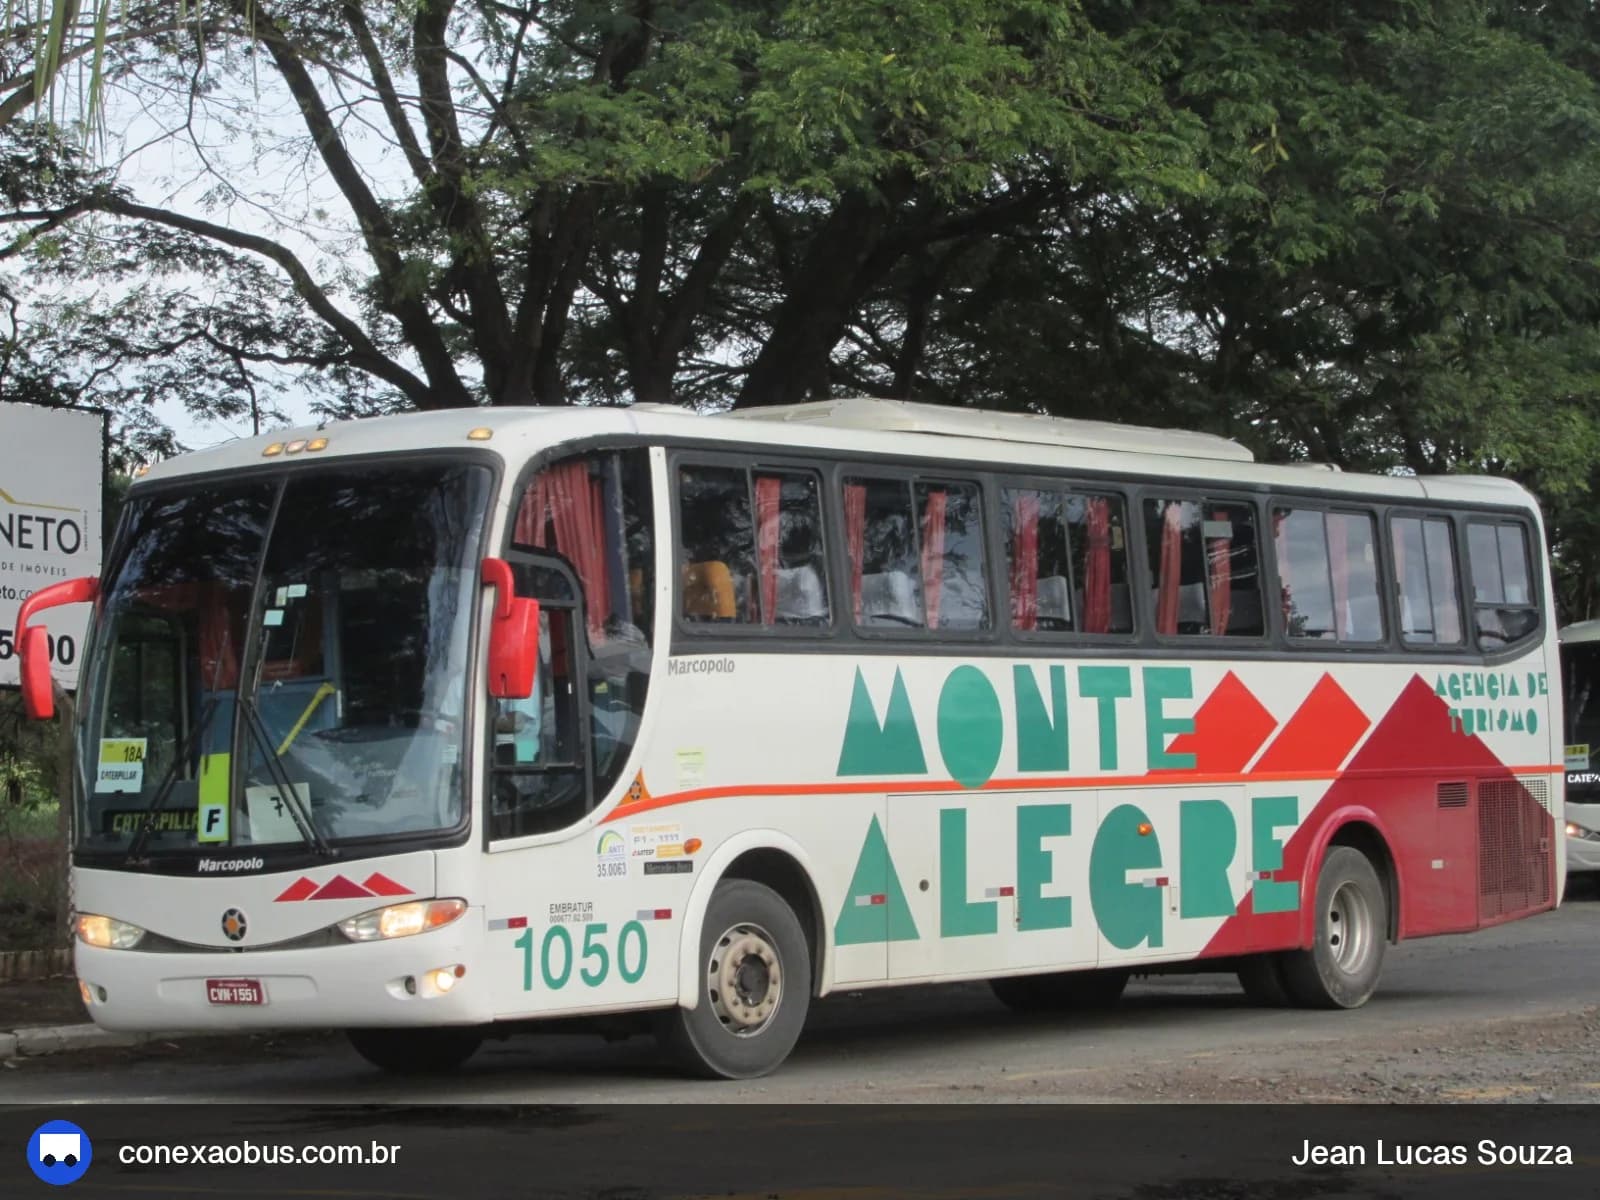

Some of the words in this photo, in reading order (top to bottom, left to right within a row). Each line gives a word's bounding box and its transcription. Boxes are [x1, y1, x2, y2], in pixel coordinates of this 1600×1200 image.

[0, 512, 81, 554] NETO
[1, 561, 14, 571] DE
[668, 658, 736, 676] Marcopolo
[1527, 671, 1549, 699] DE
[836, 663, 1197, 789] MONTE
[1447, 707, 1538, 736] TURISMO
[123, 745, 143, 763] 18A
[100, 769, 138, 780] CATERPILLAR
[270, 796, 284, 818] 7
[205, 808, 221, 833] F
[198, 857, 264, 873] Marcopolo
[834, 796, 1300, 950] ALEGRE
[549, 902, 593, 914] EMBRATUR
[514, 920, 648, 991] 1050
